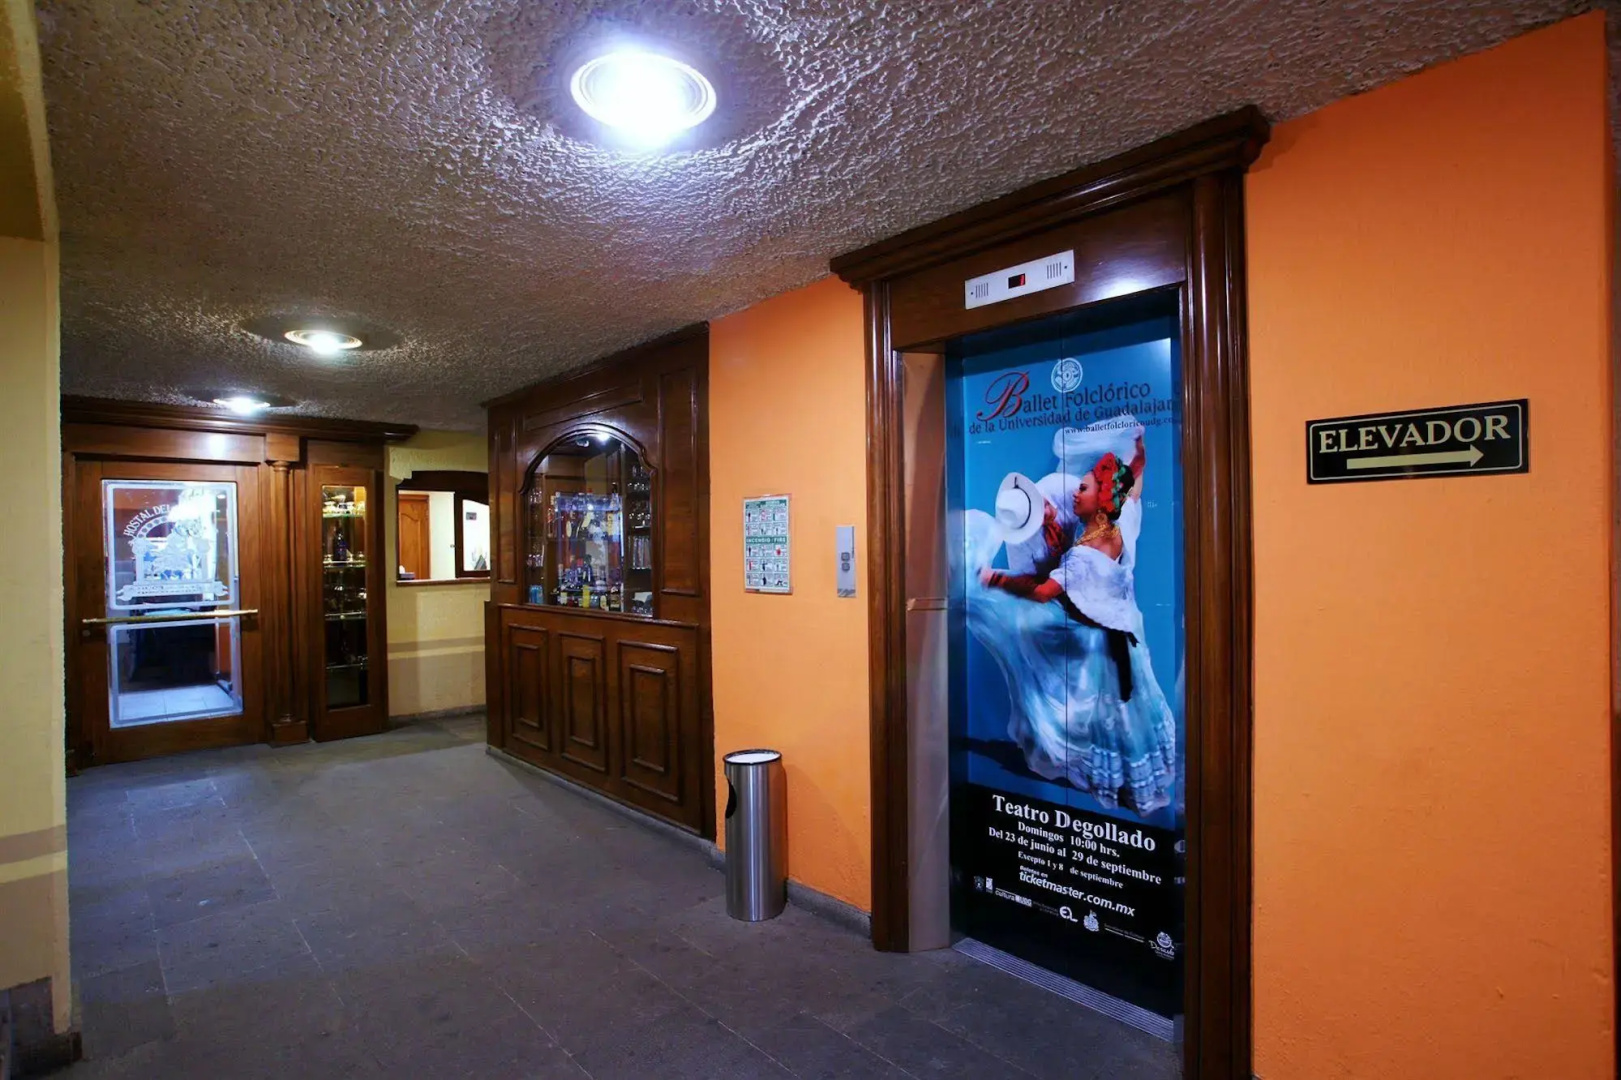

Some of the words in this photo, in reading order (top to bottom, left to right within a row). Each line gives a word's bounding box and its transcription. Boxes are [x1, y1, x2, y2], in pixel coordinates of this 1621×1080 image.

[976, 371, 1058, 421] Ballet
[1066, 382, 1151, 408] Folclórico
[969, 422, 982, 434] de
[985, 419, 995, 432] la
[999, 407, 1071, 431] Universidad
[1076, 408, 1089, 421] de
[1319, 415, 1511, 454] ELEVADOR
[123, 509, 155, 537] HOSTAL
[992, 794, 1049, 824] Teatro
[1054, 810, 1156, 851] Degollado
[1018, 821, 1064, 843] Domingos
[1070, 836, 1097, 852] 10:00
[1100, 843, 1120, 858] hrs.
[989, 827, 1003, 839] Del
[1005, 832, 1016, 843] 23
[1017, 835, 1029, 847] de
[1030, 839, 1055, 854] junio
[1057, 848, 1066, 858] al
[1072, 850, 1084, 862] 29
[1086, 855, 1099, 866] de
[1101, 861, 1162, 885] septiembre
[1018, 851, 1046, 865] Excepto
[1052, 862, 1058, 870] y
[1058, 863, 1064, 871] 8
[1069, 867, 1079, 875] de
[1080, 870, 1124, 889] septiembre
[1019, 871, 1136, 917] ticketmaster.com.mx
